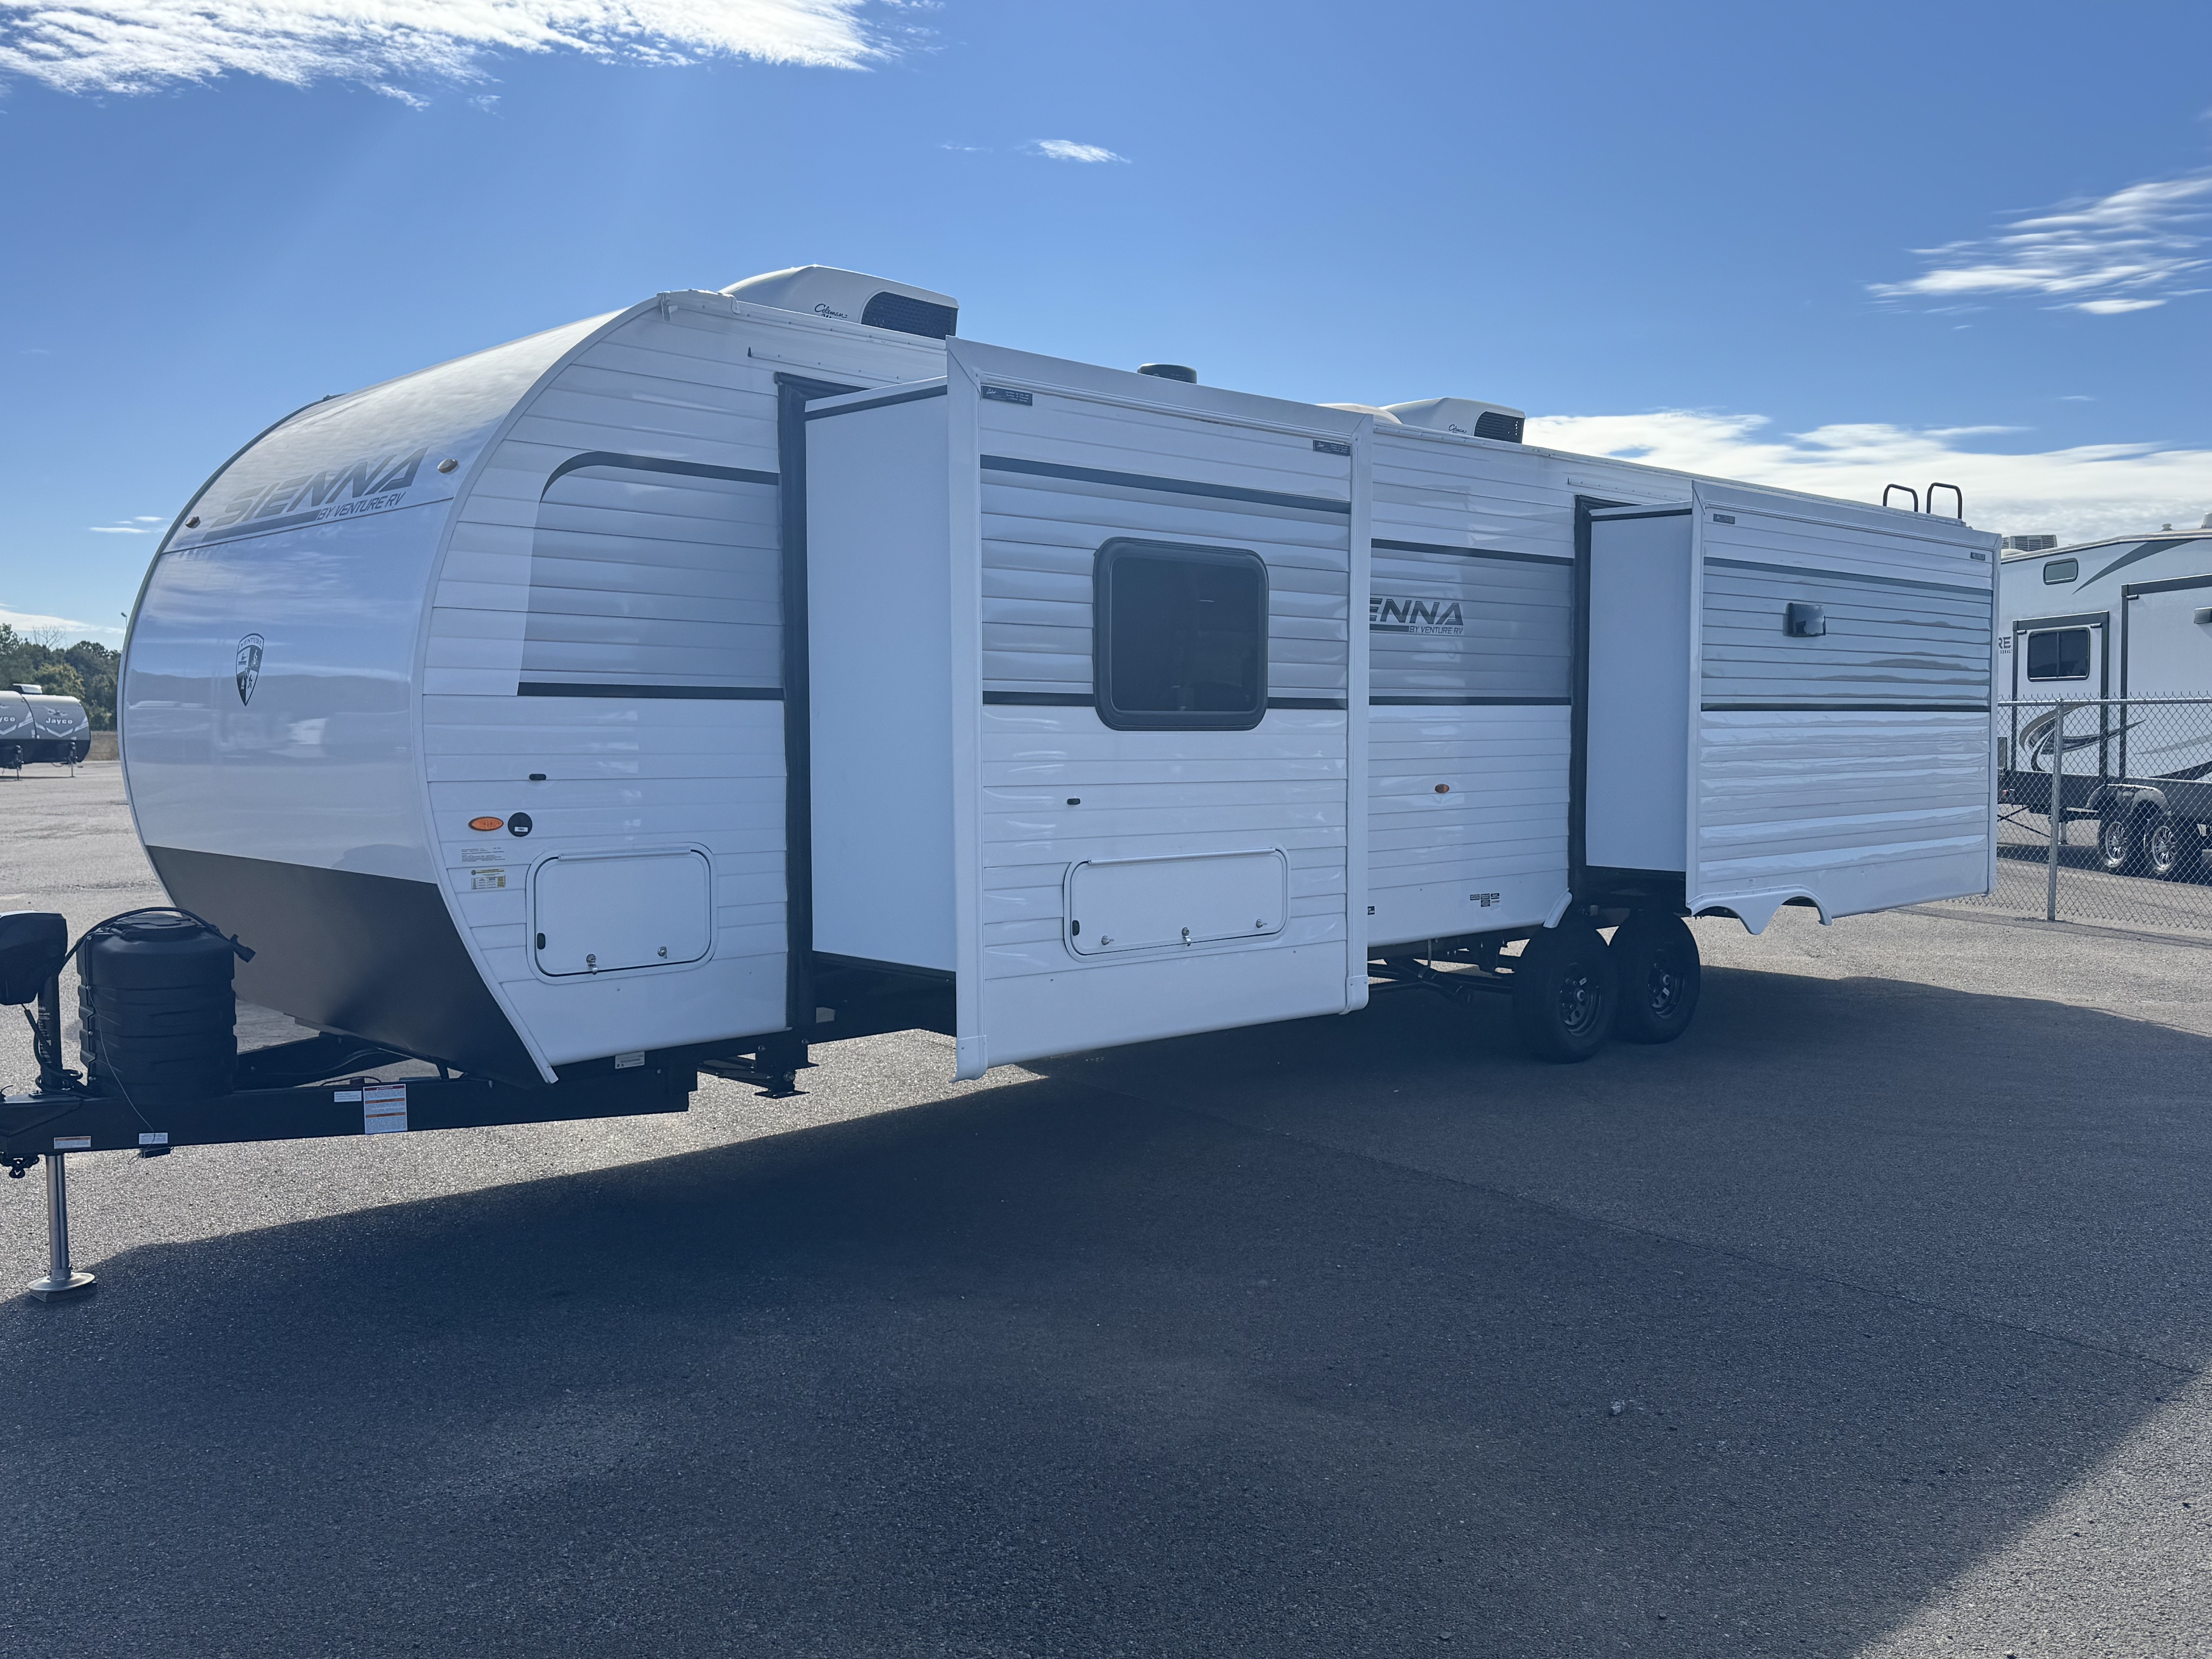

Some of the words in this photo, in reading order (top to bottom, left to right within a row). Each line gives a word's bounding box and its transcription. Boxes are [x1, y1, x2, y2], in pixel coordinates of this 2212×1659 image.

[210, 447, 429, 528] SIENNA
[316, 505, 336, 521] BY
[334, 495, 388, 517] VENTURE
[385, 491, 407, 508] RV
[1421, 626, 1453, 634] VENTURE
